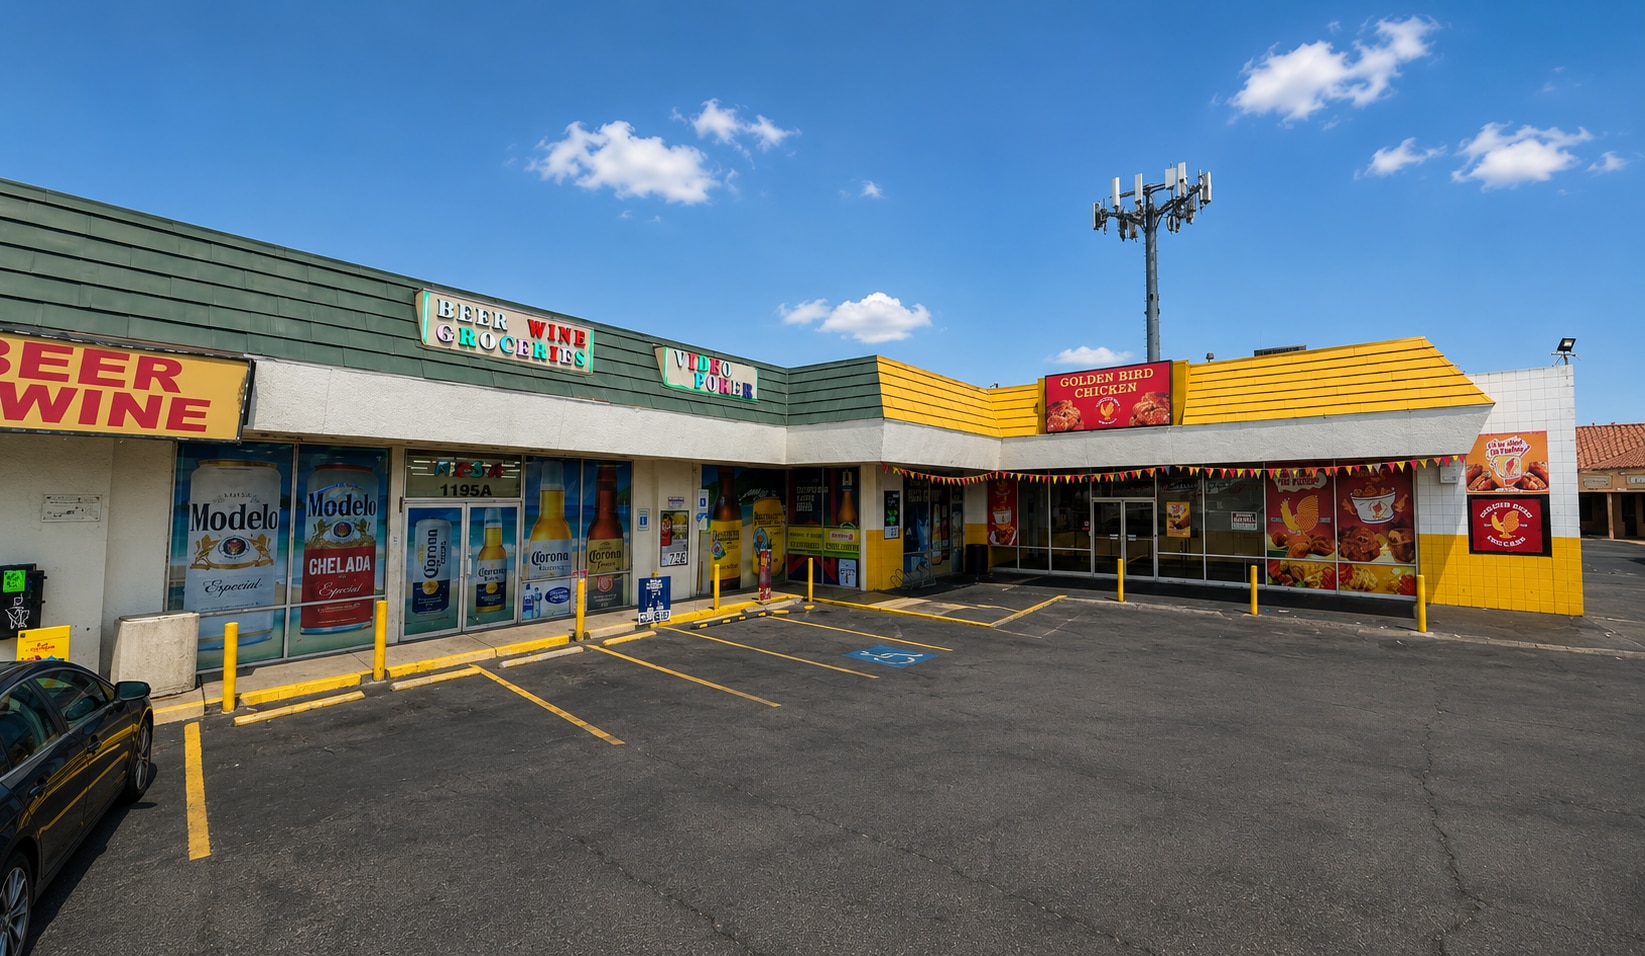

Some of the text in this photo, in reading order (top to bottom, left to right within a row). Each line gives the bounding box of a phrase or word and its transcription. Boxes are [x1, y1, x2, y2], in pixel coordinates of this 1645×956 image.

[437, 299, 586, 347] BEER WINE
[436, 324, 585, 367] GROCERIES
[0, 340, 183, 393] EER
[674, 350, 731, 378] VIDEO
[694, 372, 753, 399] POKER
[1060, 368, 1154, 387] GOLDEN BIRD
[1074, 382, 1137, 398] CHICKEN
[0, 382, 211, 432] WINE
[440, 484, 492, 497] 1195A
[189, 503, 278, 531] Modelo
[307, 493, 376, 517] Modelo
[309, 555, 371, 575] CHELADA
[531, 551, 569, 566] Corona
[589, 550, 621, 563] Corona
